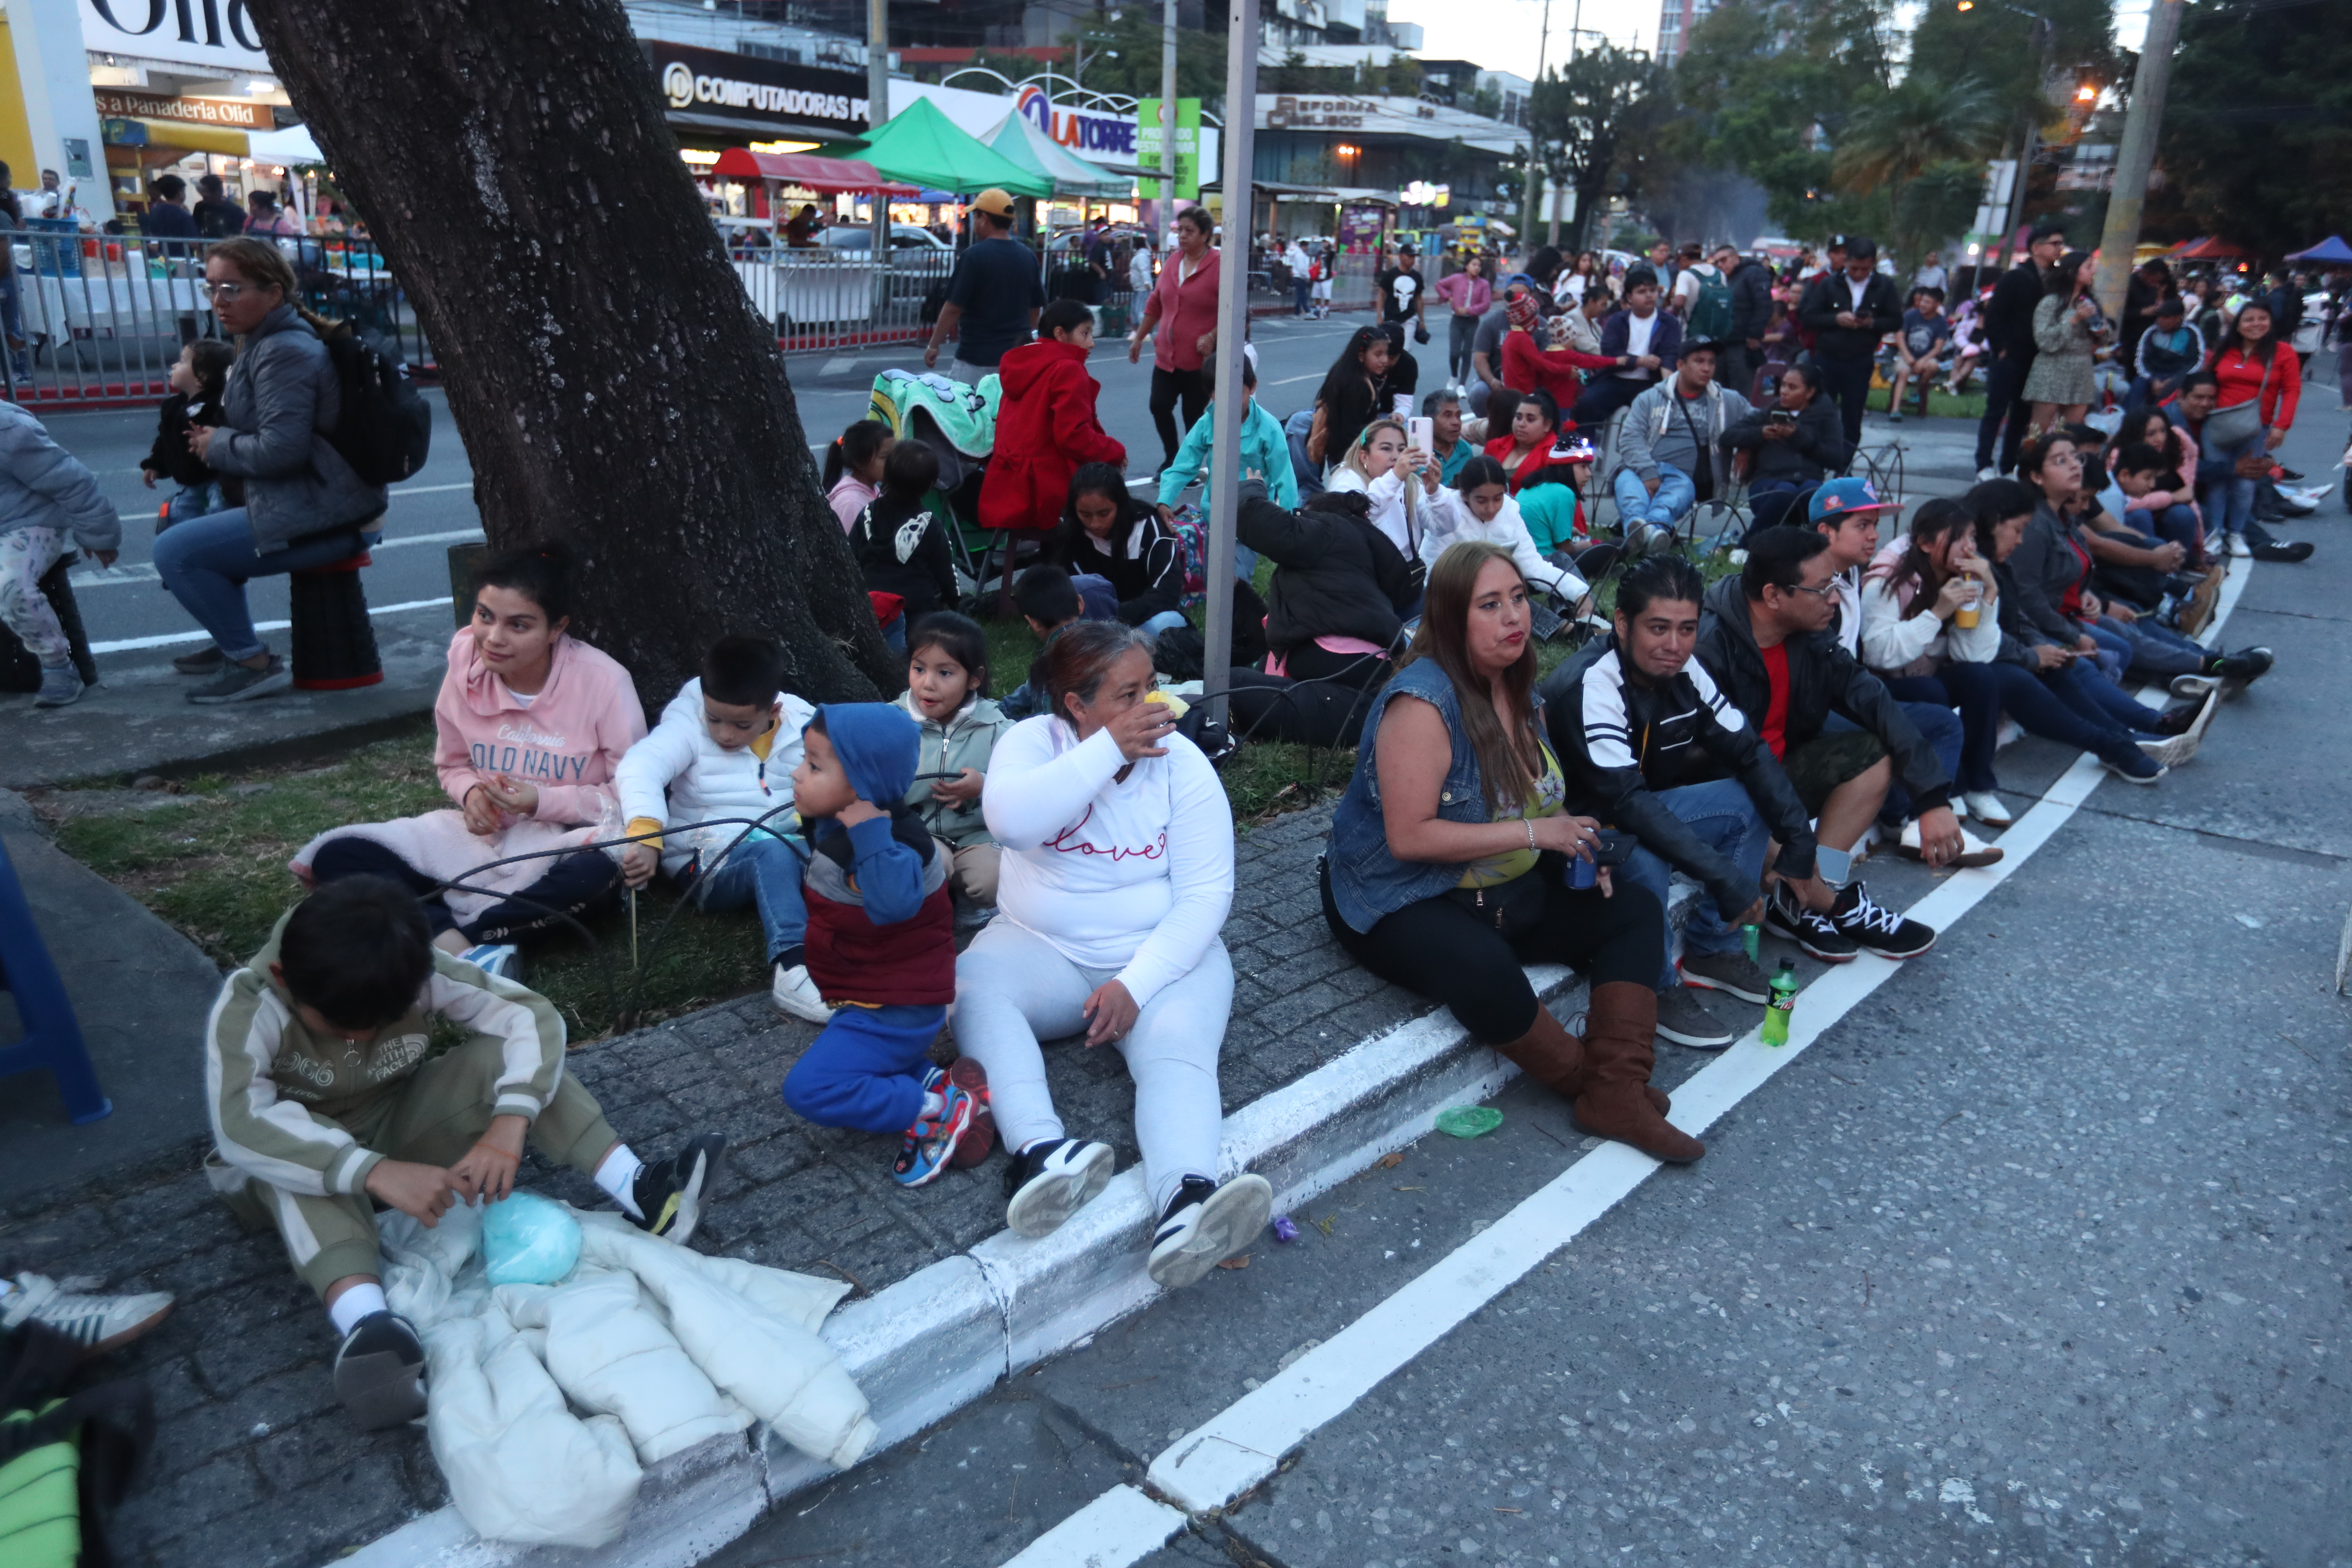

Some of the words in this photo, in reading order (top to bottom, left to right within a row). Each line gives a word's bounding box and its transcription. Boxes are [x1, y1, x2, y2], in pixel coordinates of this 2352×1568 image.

[111, 98, 122, 112] a
[126, 95, 217, 121] Panaderia
[220, 103, 254, 124] Olid
[695, 75, 849, 120] COMPUTADORAS
[498, 724, 566, 747] California
[473, 743, 518, 772] OLD
[522, 749, 587, 780] NAVY
[379, 1037, 402, 1055] THE
[375, 1056, 407, 1081] FACE
